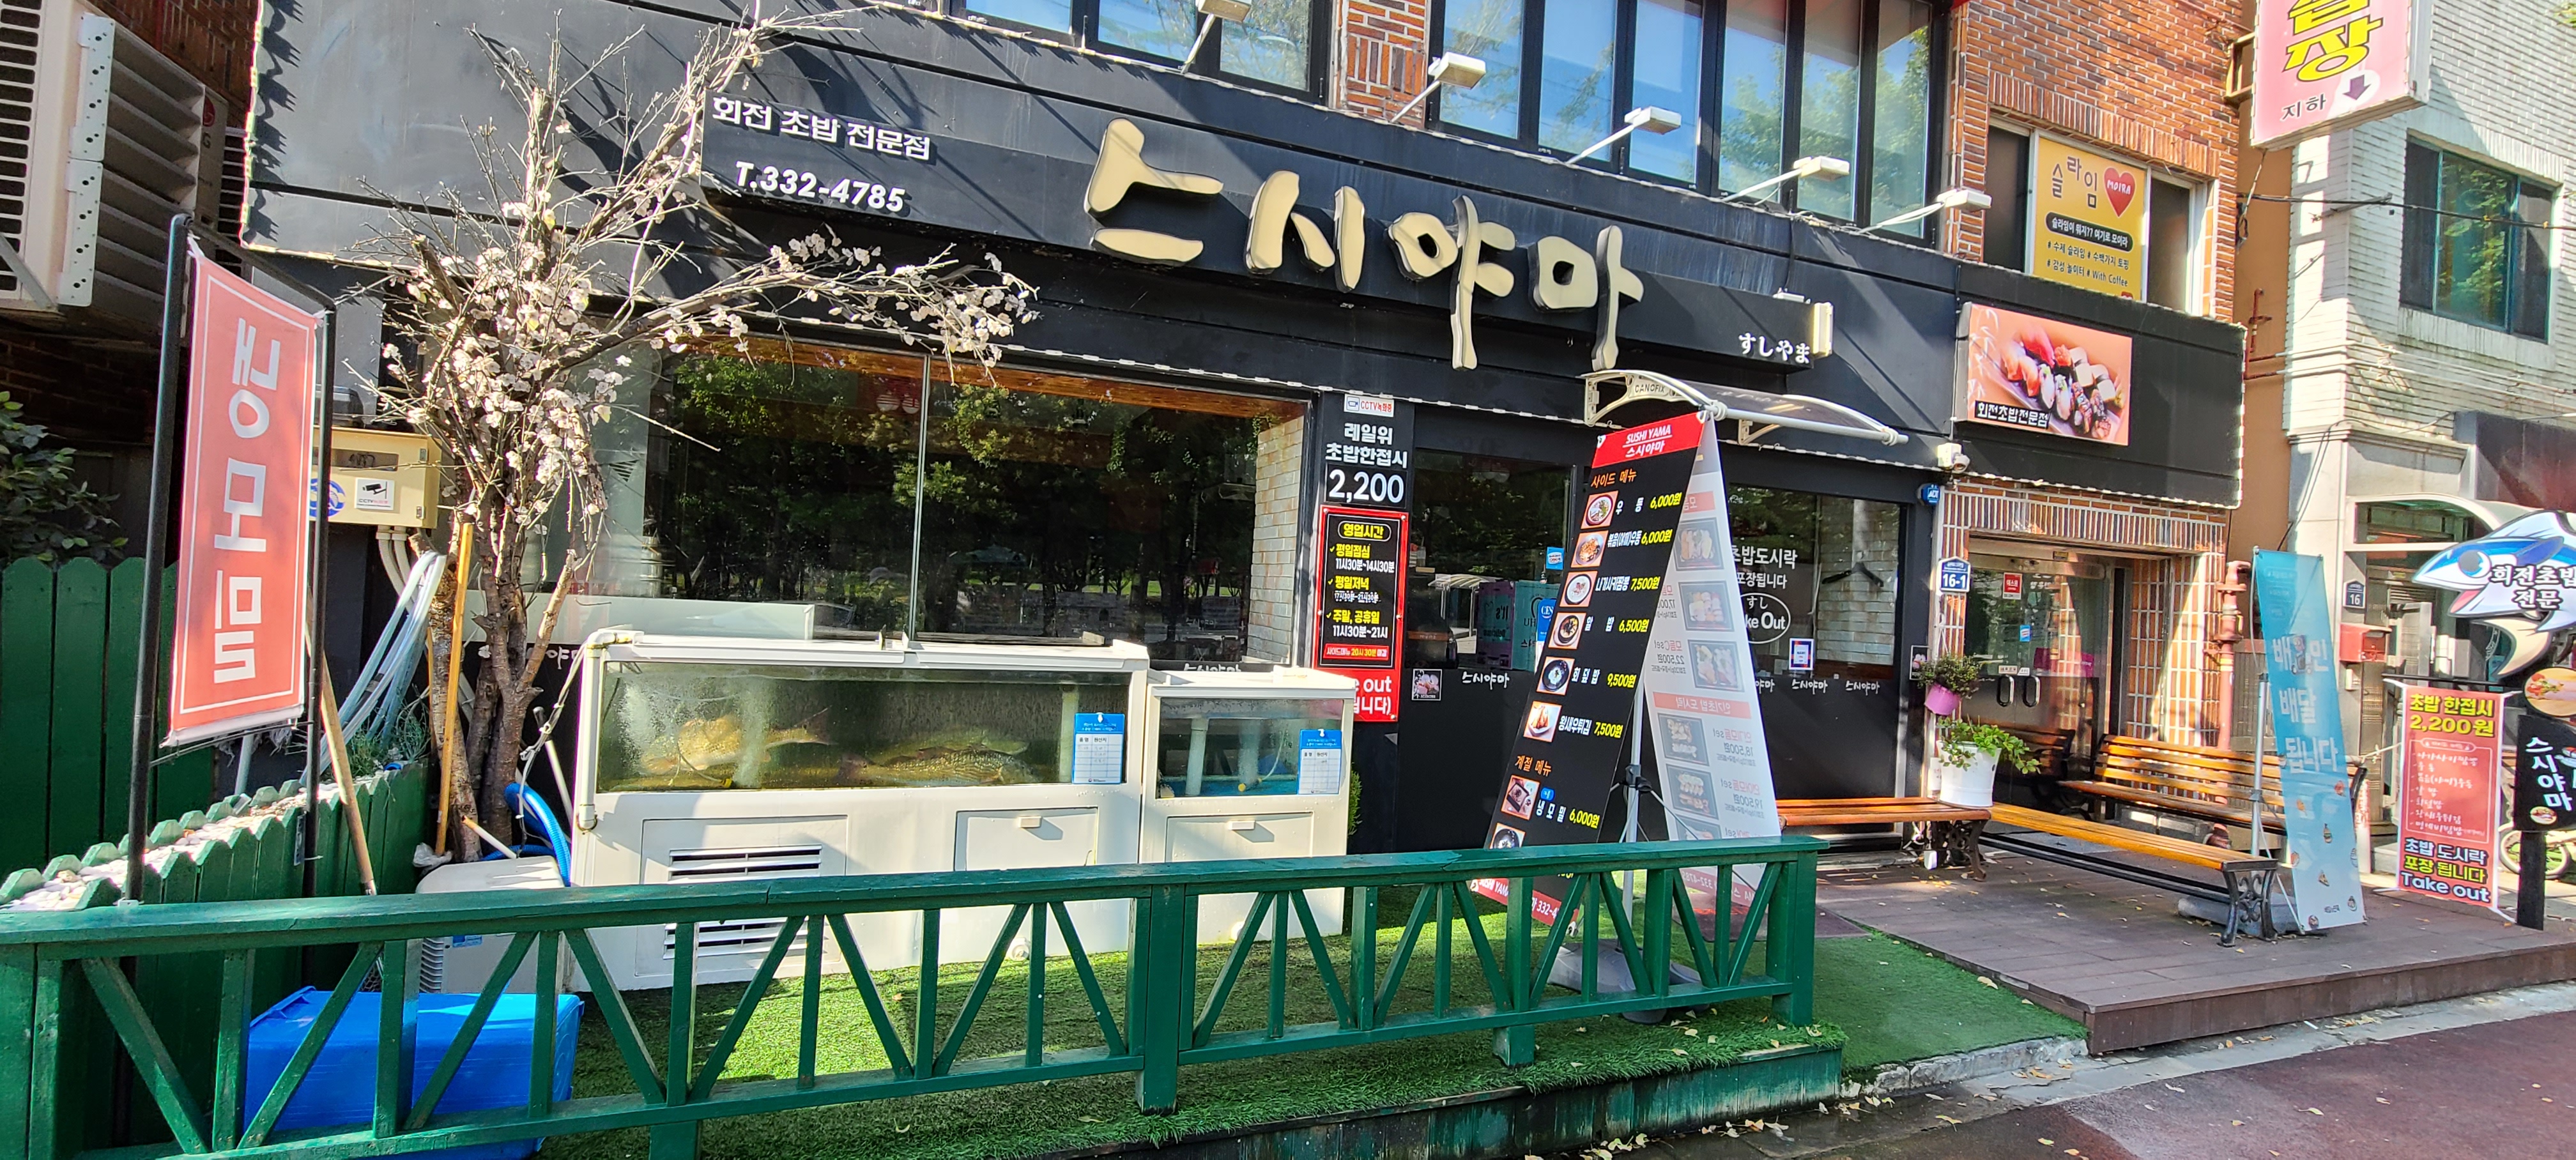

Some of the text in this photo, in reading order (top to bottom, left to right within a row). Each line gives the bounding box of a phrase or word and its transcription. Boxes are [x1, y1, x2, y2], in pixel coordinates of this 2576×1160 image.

[2281, 93, 2326, 121] 지하
[712, 96, 931, 160] 회전 초밥 전문점
[735, 161, 906, 213] T.332-4785
[2052, 156, 2097, 209] 슬라임
[2106, 179, 2131, 195] MOIRA
[2051, 217, 2075, 234] 슬라임이
[2112, 233, 2128, 248] 모이라
[1084, 117, 1644, 371] 스시야마
[2053, 241, 2066, 254] 수제
[2067, 245, 2085, 259] 슬라임
[2118, 256, 2129, 270] 토핑
[2053, 259, 2065, 272] 감성
[2067, 263, 2085, 277] 놀이터
[2092, 271, 2106, 282] With
[2108, 274, 2128, 287] Coffee
[1738, 332, 1810, 364] すしやま
[1634, 383, 1666, 393] CANOFIX
[1977, 402, 2050, 427] 회전초밥전문점
[1344, 422, 1393, 445] 레일위
[1625, 424, 1672, 444] SUSHI YAMA
[1325, 442, 1407, 469] 초밥한접시
[1625, 440, 1665, 458] 스시야마
[1329, 469, 1404, 503] 2,200
[1591, 468, 1637, 488] 사이드 메뉴
[1650, 492, 1682, 510] 6,000원
[1343, 523, 1384, 539] 영업시간
[1641, 528, 1673, 546] 6,000원
[1336, 544, 1370, 559] 평일점심
[1335, 576, 1370, 590] 평일저녁
[1630, 576, 1660, 591] 7,500원
[1736, 572, 1788, 590] 포장됩니다
[1943, 573, 1966, 588] 16-1
[1747, 595, 1768, 610] すし
[2349, 593, 2361, 605] 16
[2514, 588, 2561, 609] 전문
[1333, 609, 1380, 624] 주말, 공휴일
[1618, 619, 1650, 633] 6,500원
[1745, 612, 1786, 630] ke Out
[1333, 625, 1388, 639] 11시30분~21시
[1363, 675, 1392, 693] out
[1462, 671, 1510, 690] 스시야마
[1607, 673, 1637, 688] 9,500원
[1791, 678, 1828, 695] 스시야마
[1845, 680, 1880, 696] 스시야마
[2280, 687, 2316, 724] 배달
[2409, 693, 2493, 717] 초밥 한접시
[1558, 715, 1623, 738] 왕새우튀김 7,500원
[2409, 714, 2494, 737] 2,200원
[2285, 736, 2338, 774] 됩니다
[1515, 755, 1552, 777] 계절 메뉴
[2526, 736, 2573, 812] 스시야마
[1569, 807, 1600, 828] 6,000원
[2405, 838, 2487, 865] 초밥 도시락
[2404, 855, 2485, 883] 포장 됩니다
[2401, 871, 2490, 903] Take out
[1536, 900, 1560, 919] 332-4
